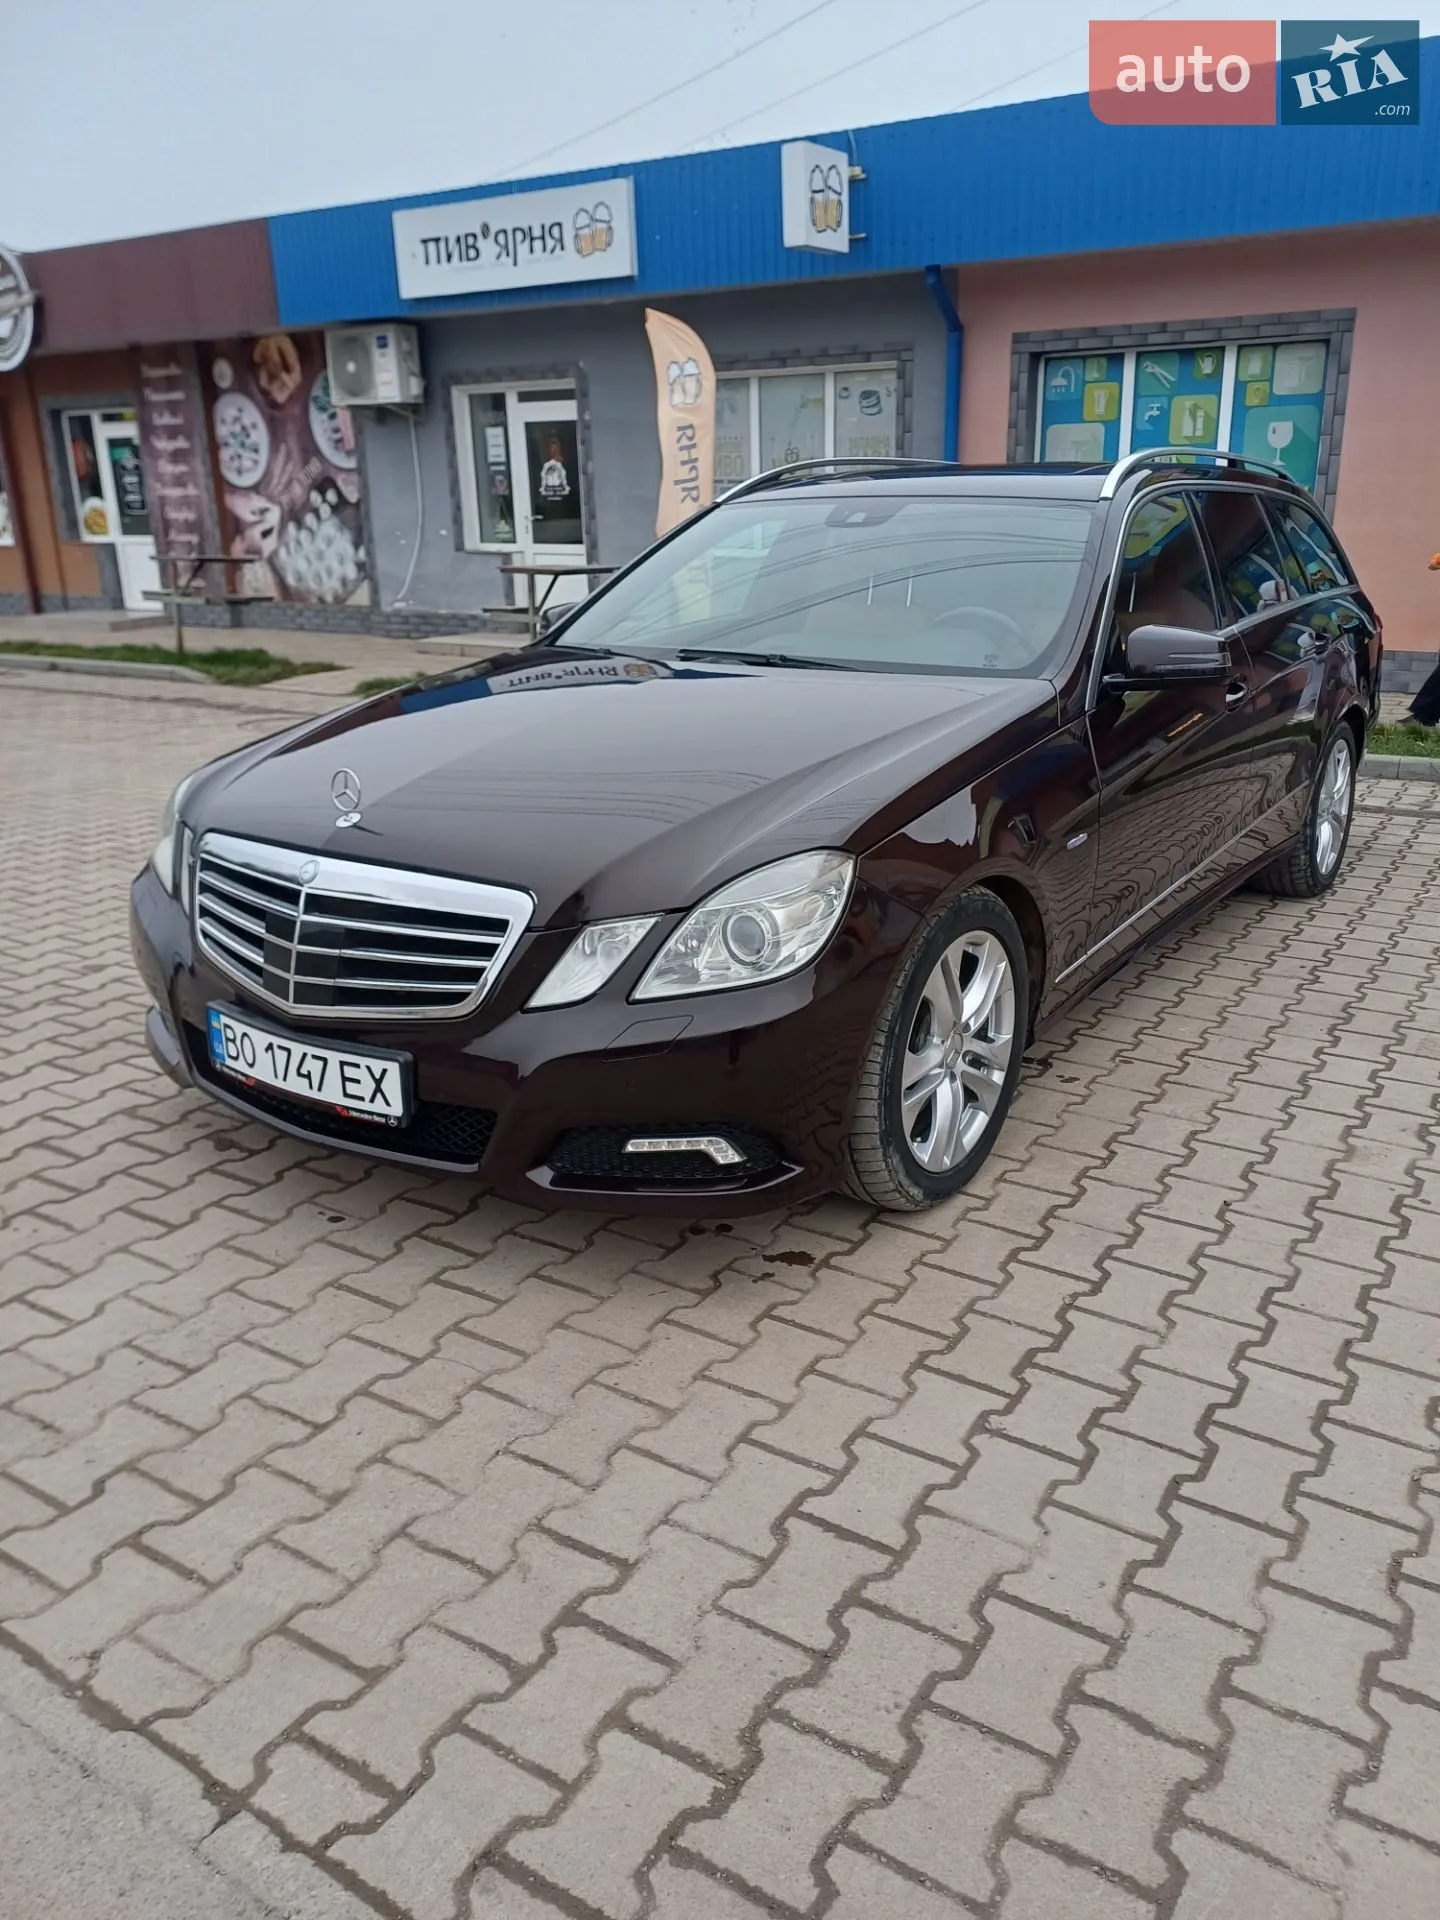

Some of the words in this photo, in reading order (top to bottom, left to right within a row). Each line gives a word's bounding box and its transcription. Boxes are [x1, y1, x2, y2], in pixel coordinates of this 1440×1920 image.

[223, 1022, 256, 1069] BO
[265, 1042, 328, 1093] 1747
[339, 1060, 392, 1108] EX
